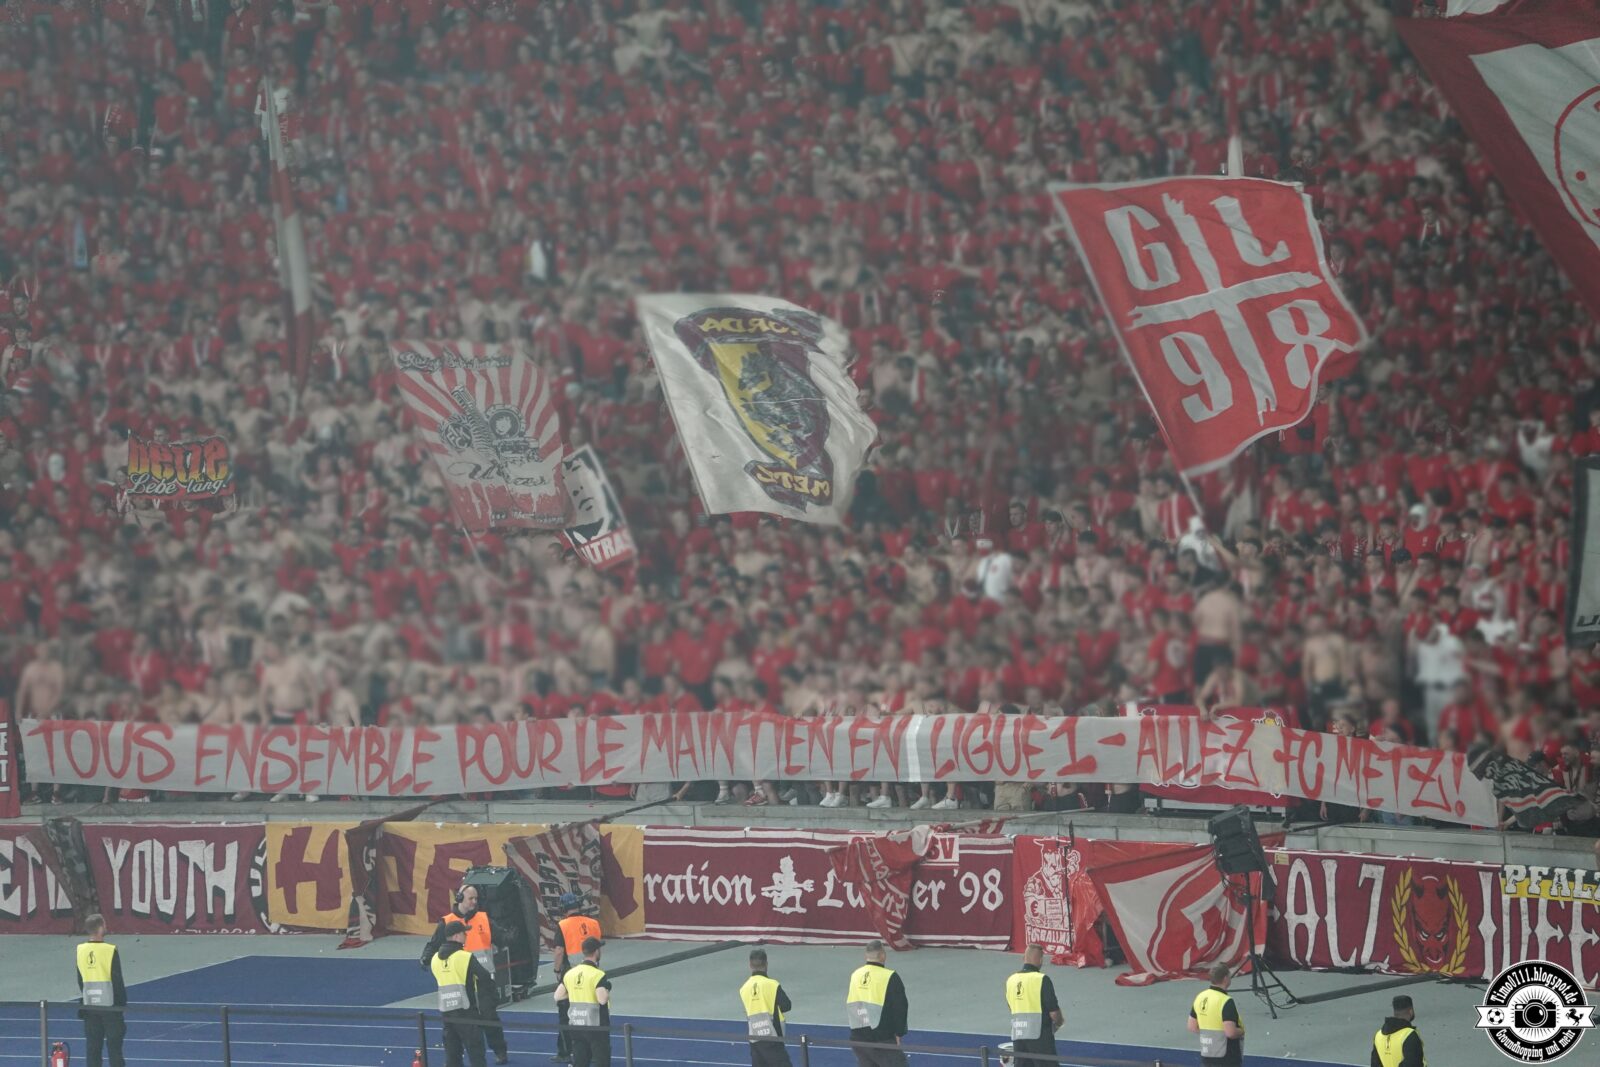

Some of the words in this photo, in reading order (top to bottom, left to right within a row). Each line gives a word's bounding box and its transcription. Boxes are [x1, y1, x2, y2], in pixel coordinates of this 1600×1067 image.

[27, 720, 175, 782] TOUS
[194, 724, 442, 796] ENSEMBLE
[456, 719, 563, 789] POUR
[575, 715, 627, 783] LE
[640, 711, 843, 780] MAINTIEN
[849, 714, 914, 781] EN
[1136, 715, 1260, 787] ALLEZ
[1272, 726, 1324, 800] FC
[1336, 733, 1468, 818] METZ!
[101, 836, 239, 920] YOUTH
